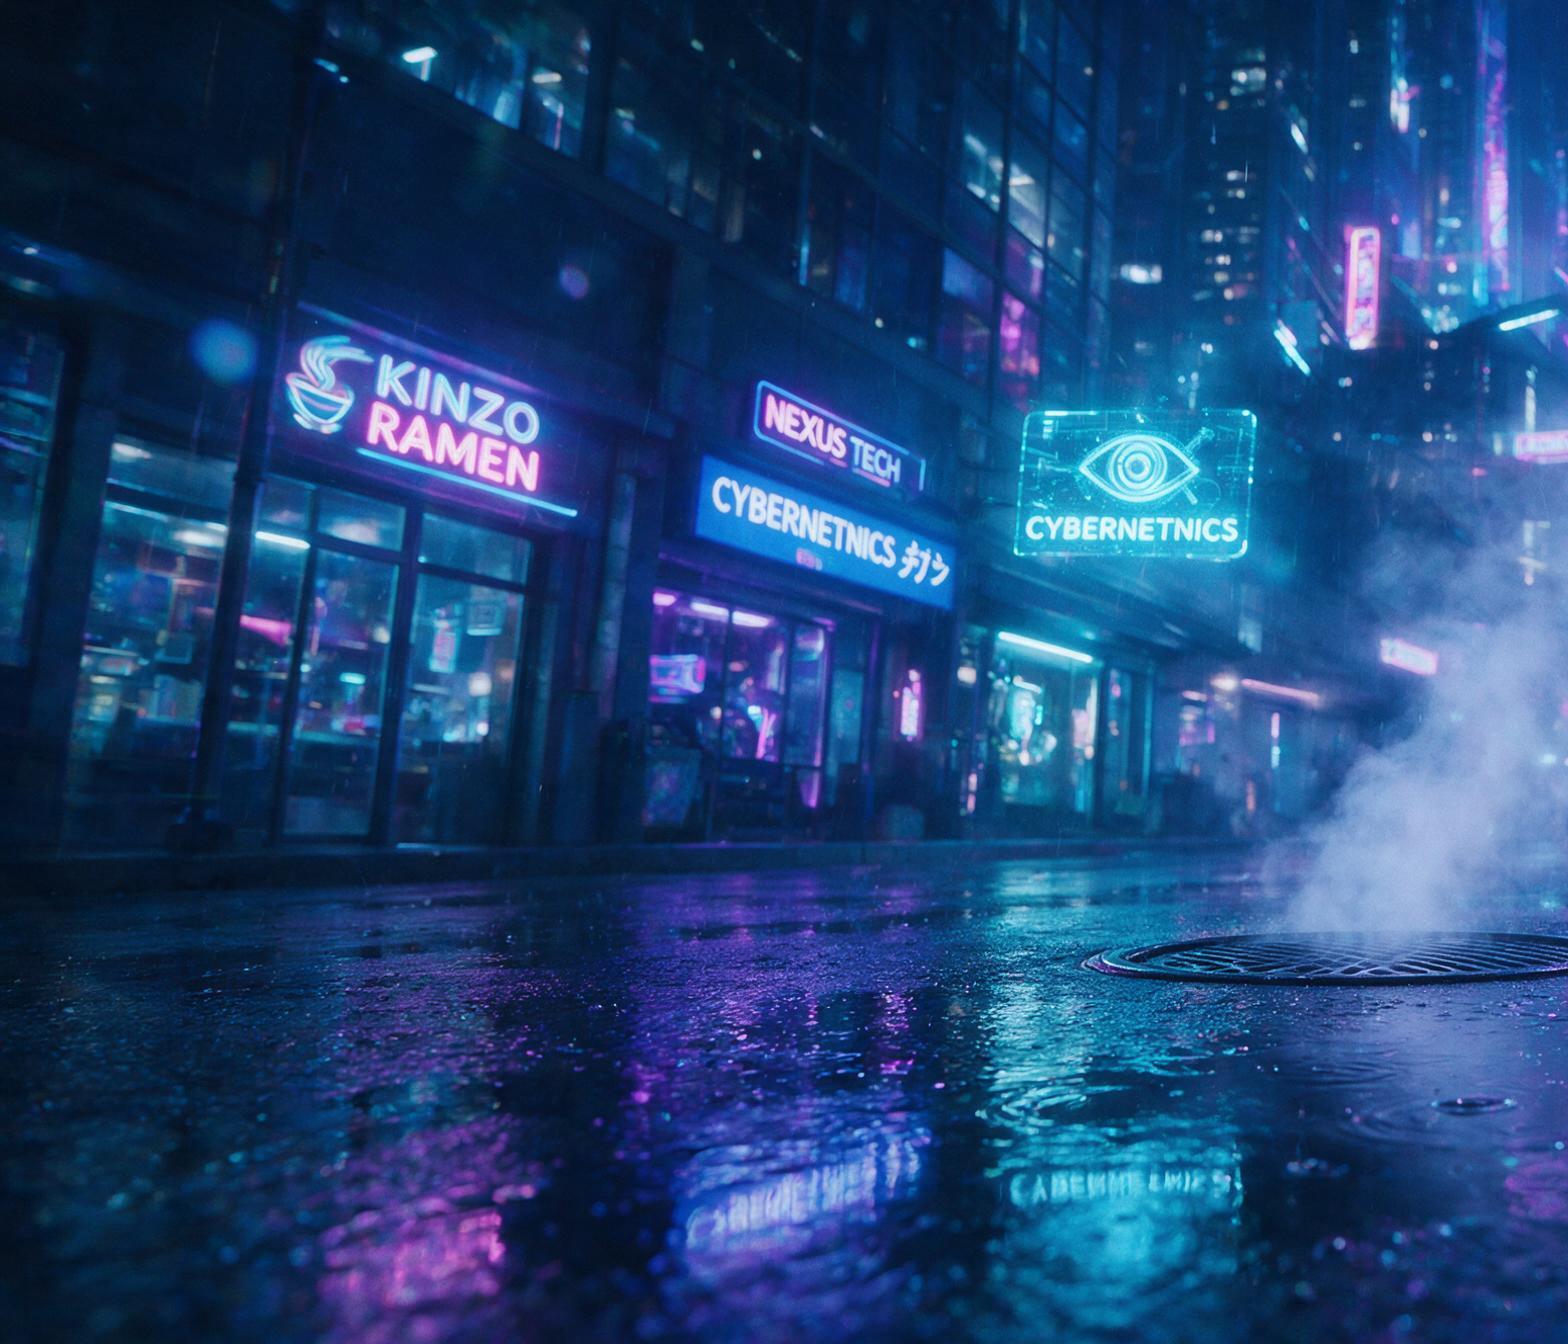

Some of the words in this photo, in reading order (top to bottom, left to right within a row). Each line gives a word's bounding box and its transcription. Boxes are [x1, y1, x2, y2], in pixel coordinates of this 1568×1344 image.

[377, 354, 540, 444] KINZO
[764, 394, 847, 459] NEXUS
[850, 435, 901, 483] TECH
[366, 401, 540, 492] RAMEN
[711, 475, 897, 568] CYBERNETNICS
[1025, 515, 1239, 542] CYBERNETNICS
